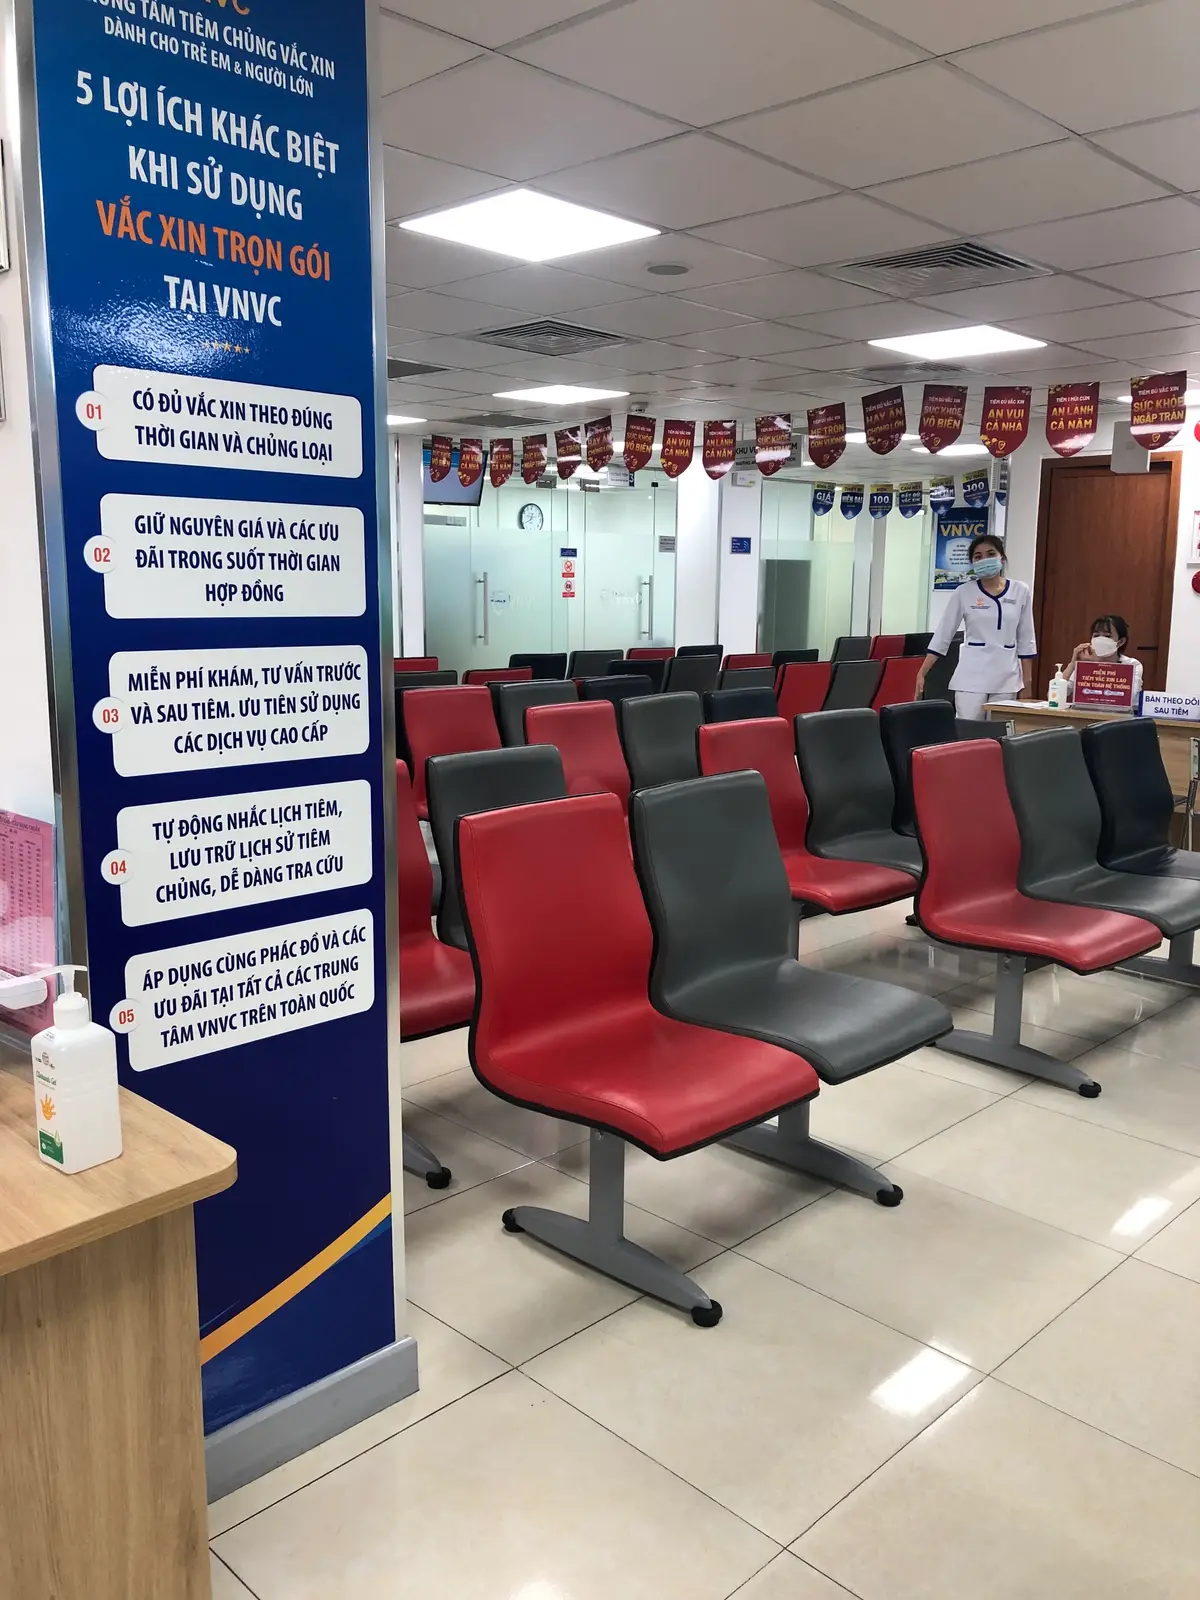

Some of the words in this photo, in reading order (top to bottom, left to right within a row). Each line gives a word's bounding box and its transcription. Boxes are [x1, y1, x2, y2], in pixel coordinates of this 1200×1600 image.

[140, 0, 175, 27] TÂM
[179, 10, 218, 41] TIÊM
[224, 26, 276, 60] CHỦNG
[280, 43, 307, 70] VẮC
[311, 54, 334, 79] XIN
[105, 16, 146, 44] DÀNH
[150, 32, 178, 54] CHO
[182, 40, 207, 64] TRẺ
[212, 50, 230, 71] EM
[234, 62, 241, 74] &
[246, 61, 286, 88] NGƯỜI
[290, 76, 313, 97] LỚN
[77, 70, 92, 104] 5
[103, 76, 147, 126] LỢI
[158, 86, 202, 136] ÍCH
[212, 108, 280, 158] KHÁC
[287, 130, 339, 178] BIỆT
[129, 146, 178, 190] KHI
[187, 156, 222, 199] SỬ
[231, 172, 302, 220] DỤNG
[96, 195, 153, 244] VẮC
[160, 214, 206, 255] XIN
[212, 227, 282, 275] TRỌN
[290, 244, 330, 280] GÓI
[163, 275, 207, 319] TẠI
[213, 284, 281, 327] VNVC
[86, 403, 102, 420] 01
[133, 388, 154, 410] CÓ
[158, 389, 181, 414] ĐỦ
[186, 392, 216, 417] VẮC
[220, 400, 245, 420] XIN
[250, 404, 288, 425] THEO
[292, 407, 332, 430] ĐÚNG
[988, 409, 1003, 419] AN
[1007, 409, 1024, 419] VUI
[1052, 407, 1065, 416] AN
[1067, 404, 1094, 415] LÀNH
[1159, 409, 1184, 421] TRÀN
[986, 420, 999, 431] CẢ
[1002, 420, 1022, 431] NHÀ
[1050, 418, 1065, 430] CẢ
[1068, 418, 1092, 429] NĂM
[135, 424, 174, 447] THỜI
[180, 430, 218, 451] GIAN
[222, 431, 243, 453] VÀ
[247, 433, 298, 458] CHỦNG
[302, 442, 332, 465] LOẠI
[666, 438, 677, 446] AN
[816, 492, 832, 501] GIÁ
[873, 496, 890, 504] 100
[135, 512, 165, 534] GIỮ
[170, 515, 233, 537] NGUYÊN
[238, 517, 264, 538] GIÁ
[267, 518, 286, 539] VÀ
[290, 520, 315, 540] CÁC
[320, 522, 338, 541] ƯU
[940, 523, 985, 537] VNVC
[93, 547, 111, 563] 02
[136, 546, 164, 568] ĐÃI
[168, 550, 222, 569] TRONG
[227, 547, 265, 570] SUỐT
[268, 550, 302, 570] THỜI
[307, 554, 340, 571] GIAN
[206, 583, 237, 606] HỢP
[241, 579, 283, 601] ĐỒNG
[129, 666, 170, 691] MIỄN
[176, 667, 203, 689] PHÍ
[208, 666, 258, 688] KHÁM,
[262, 665, 281, 684] TƯ
[284, 661, 312, 683] VẤN
[316, 661, 361, 682] TRƯỚC
[131, 702, 153, 724] VÀ
[157, 704, 187, 722] SAU
[192, 698, 234, 720] TIÊM.
[239, 698, 260, 717] ƯU
[264, 694, 296, 715] TIÊN
[300, 691, 318, 712] SỬ
[323, 694, 360, 715] DỤNG
[1145, 694, 1161, 703] BÀN
[1163, 696, 1183, 705] THEO
[1154, 706, 1170, 715] SAU
[1171, 706, 1189, 716] TIÊM
[102, 708, 119, 724] 03
[174, 732, 203, 753] CÁC
[208, 731, 242, 754] DỊCH
[246, 730, 266, 750] VỤ
[271, 727, 298, 745] CAO
[302, 720, 328, 742] CẤP
[152, 819, 174, 844] TỰ
[178, 815, 222, 840] ĐỘNG
[228, 805, 267, 830] NHẮC
[271, 805, 301, 828] LỊCH
[305, 799, 342, 819] TIÊM,
[170, 848, 200, 870] LƯU
[205, 840, 236, 864] TRỮ
[240, 838, 271, 862] LỊCH
[276, 830, 294, 853] SỬ
[297, 828, 330, 849] TIÊM
[110, 860, 127, 876] 04
[156, 877, 216, 903] CHỦNG,
[221, 868, 239, 892] DỄ
[244, 866, 282, 888] DÀNG
[286, 862, 312, 880] TRA
[316, 855, 342, 874] CỨU
[143, 970, 163, 991] ÁP
[168, 960, 212, 986] DỤNG
[216, 950, 256, 973] CÙNG
[261, 940, 297, 964] PHÁC
[300, 932, 319, 955] ĐỒ
[322, 930, 339, 950] VÀ
[343, 925, 366, 945] CÁC
[154, 998, 176, 1018] ƯU
[181, 989, 206, 1012] ĐÃI
[211, 985, 233, 1007] TẠI
[237, 975, 261, 998] TẤT
[266, 969, 282, 991] CẢ
[287, 966, 311, 986] CÁC
[314, 956, 358, 980] TRUNG
[119, 1009, 135, 1024] 05
[161, 1025, 194, 1047] TÂM
[197, 1014, 237, 1038] VNVC
[240, 1004, 276, 1027] TRÊN
[280, 994, 315, 1016] TOÀN
[320, 981, 354, 1007] QUỐC
